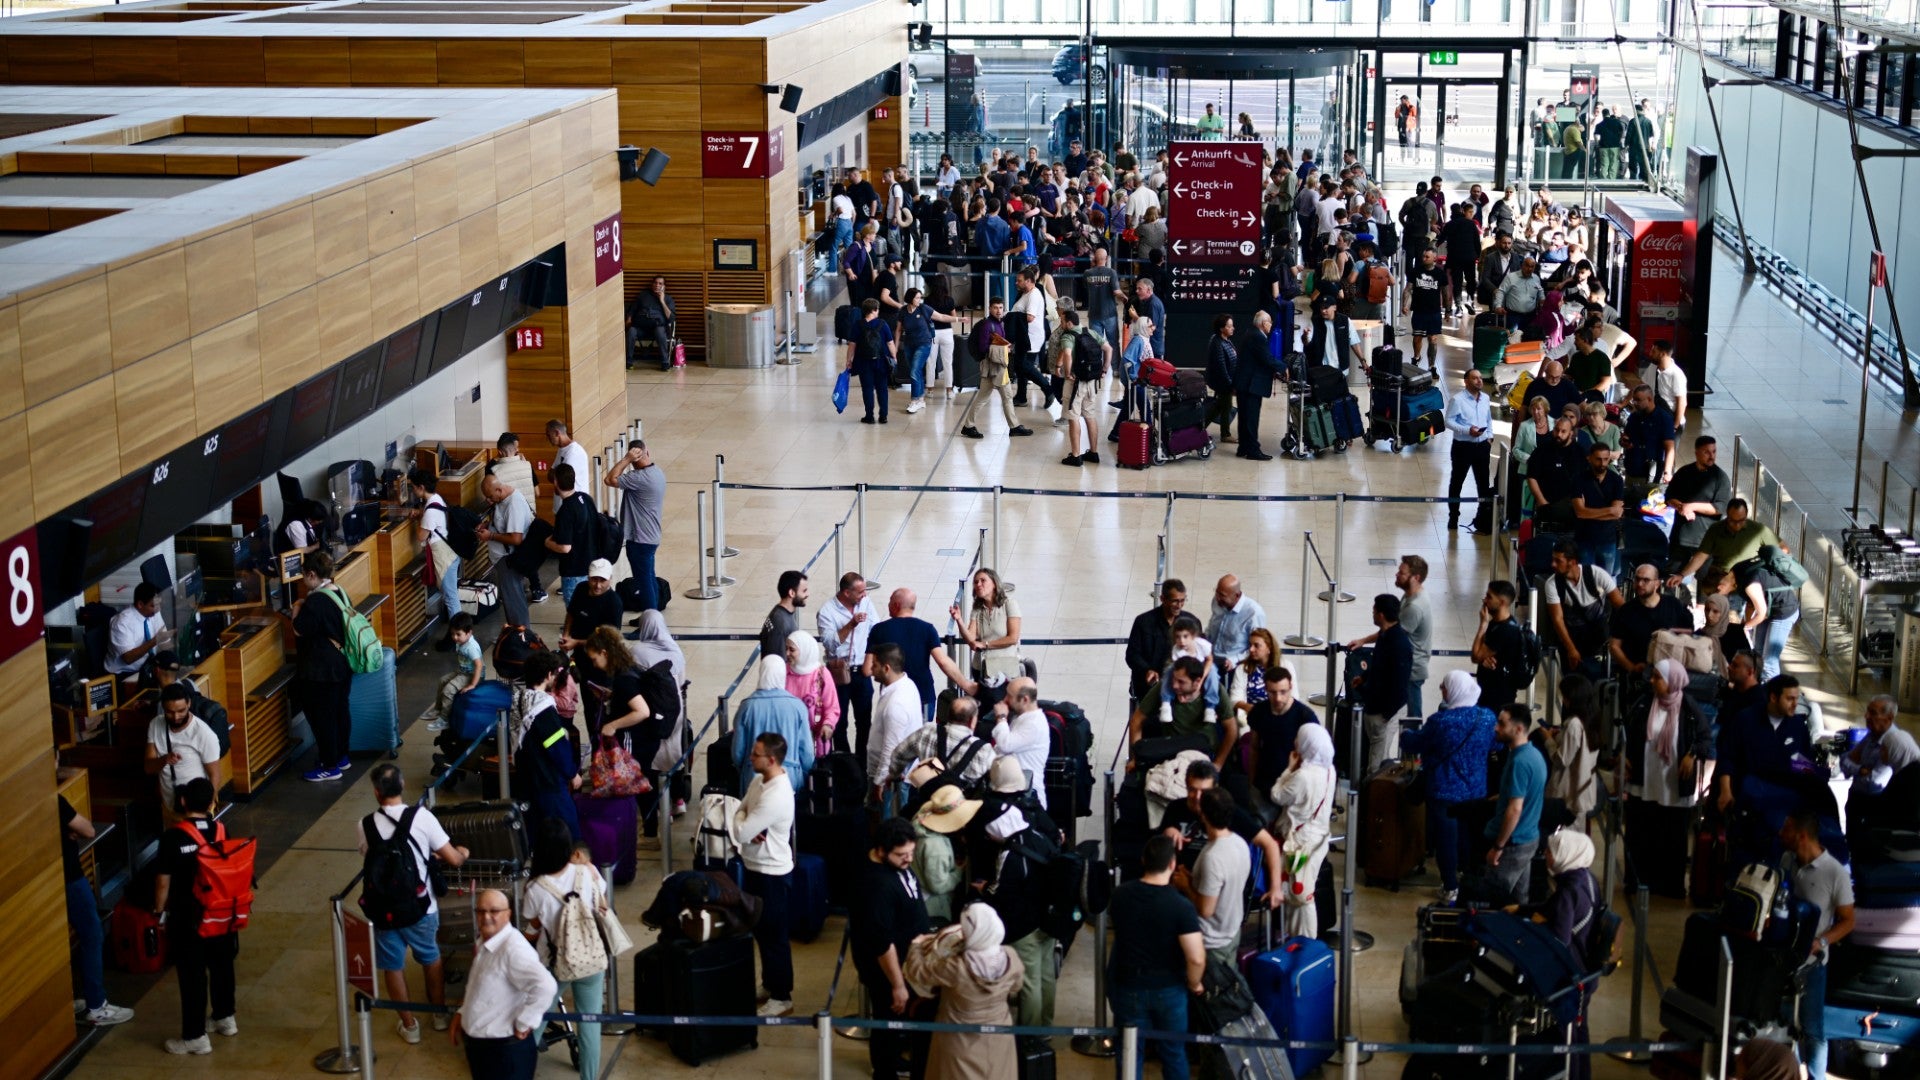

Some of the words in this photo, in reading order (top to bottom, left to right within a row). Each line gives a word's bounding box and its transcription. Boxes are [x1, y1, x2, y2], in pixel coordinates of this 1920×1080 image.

[740, 136, 759, 169] 7
[1191, 149, 1232, 159] Ankunft
[1190, 160, 1216, 168] Arrival
[1190, 180, 1234, 190] Check-in
[1196, 208, 1239, 218] Check-in
[1232, 219, 1239, 228] 9
[612, 220, 620, 262] 8
[1206, 240, 1239, 248] Terminal
[1241, 244, 1253, 253] T2
[1641, 258, 1682, 267] GOODB
[1640, 268, 1681, 279] BERLI
[203, 434, 219, 456] 825
[152, 461, 170, 485] 826
[8, 545, 34, 627] 8
[888, 1021, 903, 1029] BER
[981, 1025, 996, 1033] BER
[1458, 1045, 1473, 1053] BER
[1553, 1045, 1569, 1053] BER
